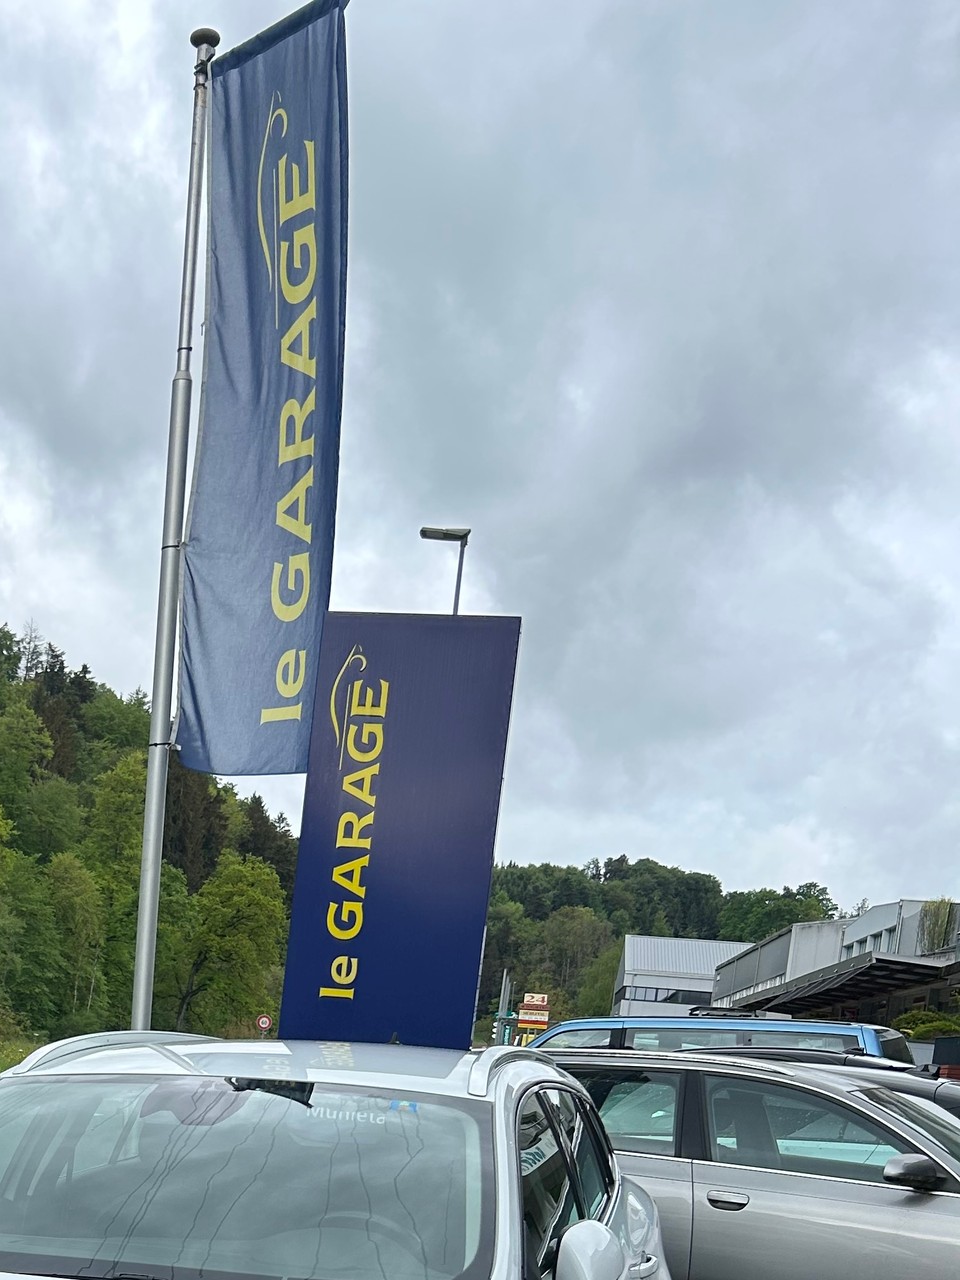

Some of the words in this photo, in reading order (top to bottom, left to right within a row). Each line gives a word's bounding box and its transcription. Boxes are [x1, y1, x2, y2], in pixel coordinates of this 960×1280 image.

[270, 138, 318, 623] GARAGE
[260, 648, 306, 725] le
[326, 678, 390, 941] GARAGE
[319, 954, 358, 1000] le
[525, 994, 547, 1004] 24
